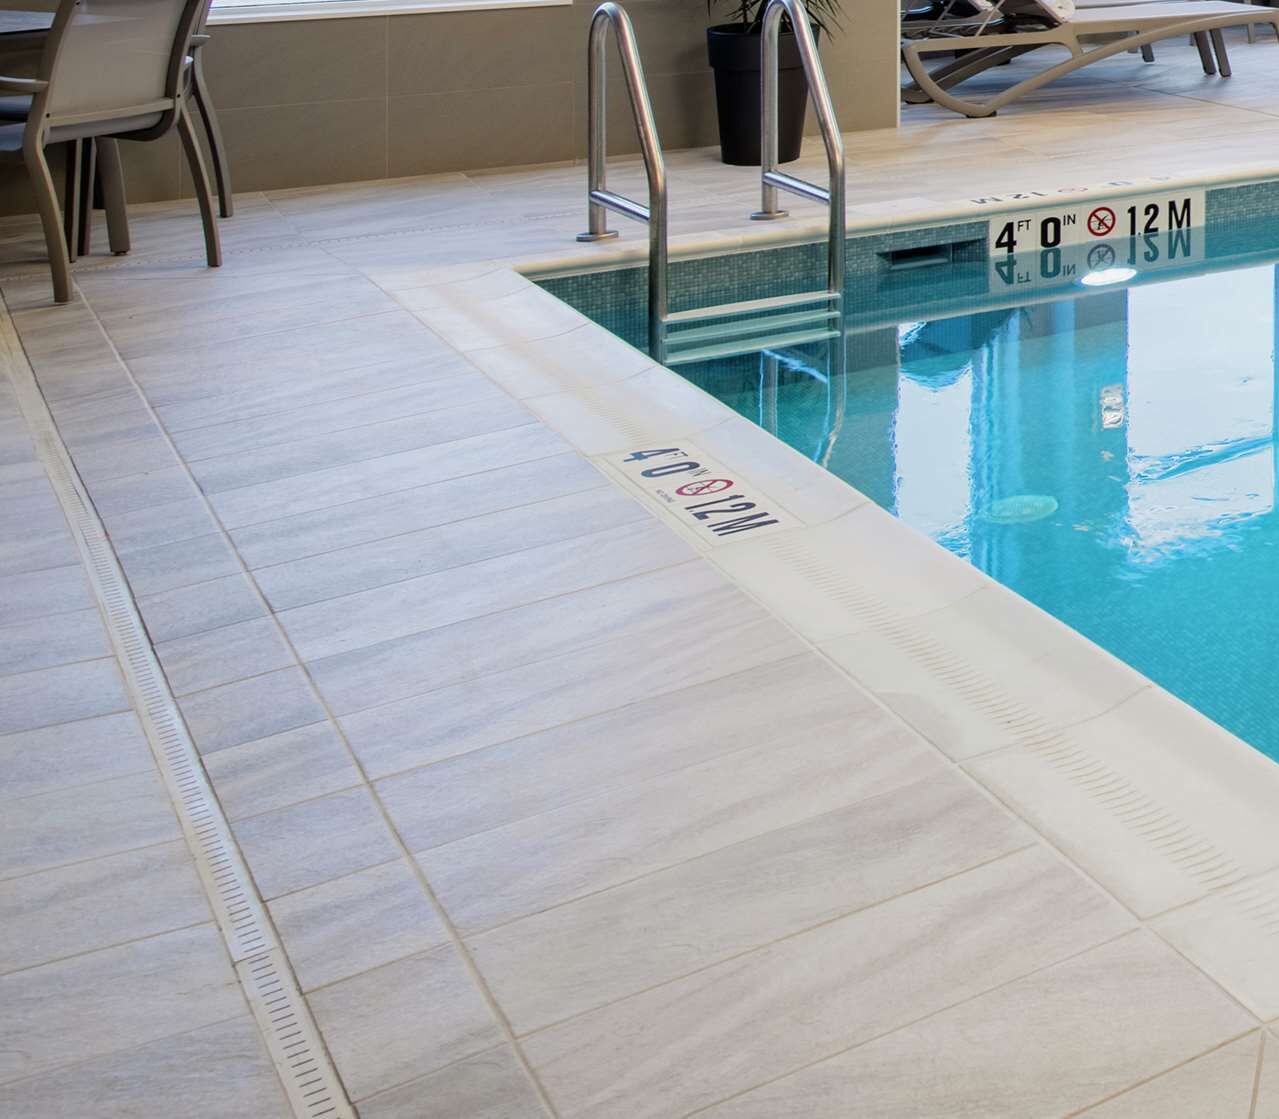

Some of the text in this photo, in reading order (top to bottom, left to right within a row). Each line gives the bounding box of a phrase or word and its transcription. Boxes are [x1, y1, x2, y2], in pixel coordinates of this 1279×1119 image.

[995, 222, 1017, 254] 4
[1017, 218, 1032, 232] FT
[1040, 216, 1061, 248] 0
[1063, 214, 1076, 226] IN
[623, 448, 680, 462] 4
[641, 461, 700, 478] 0
